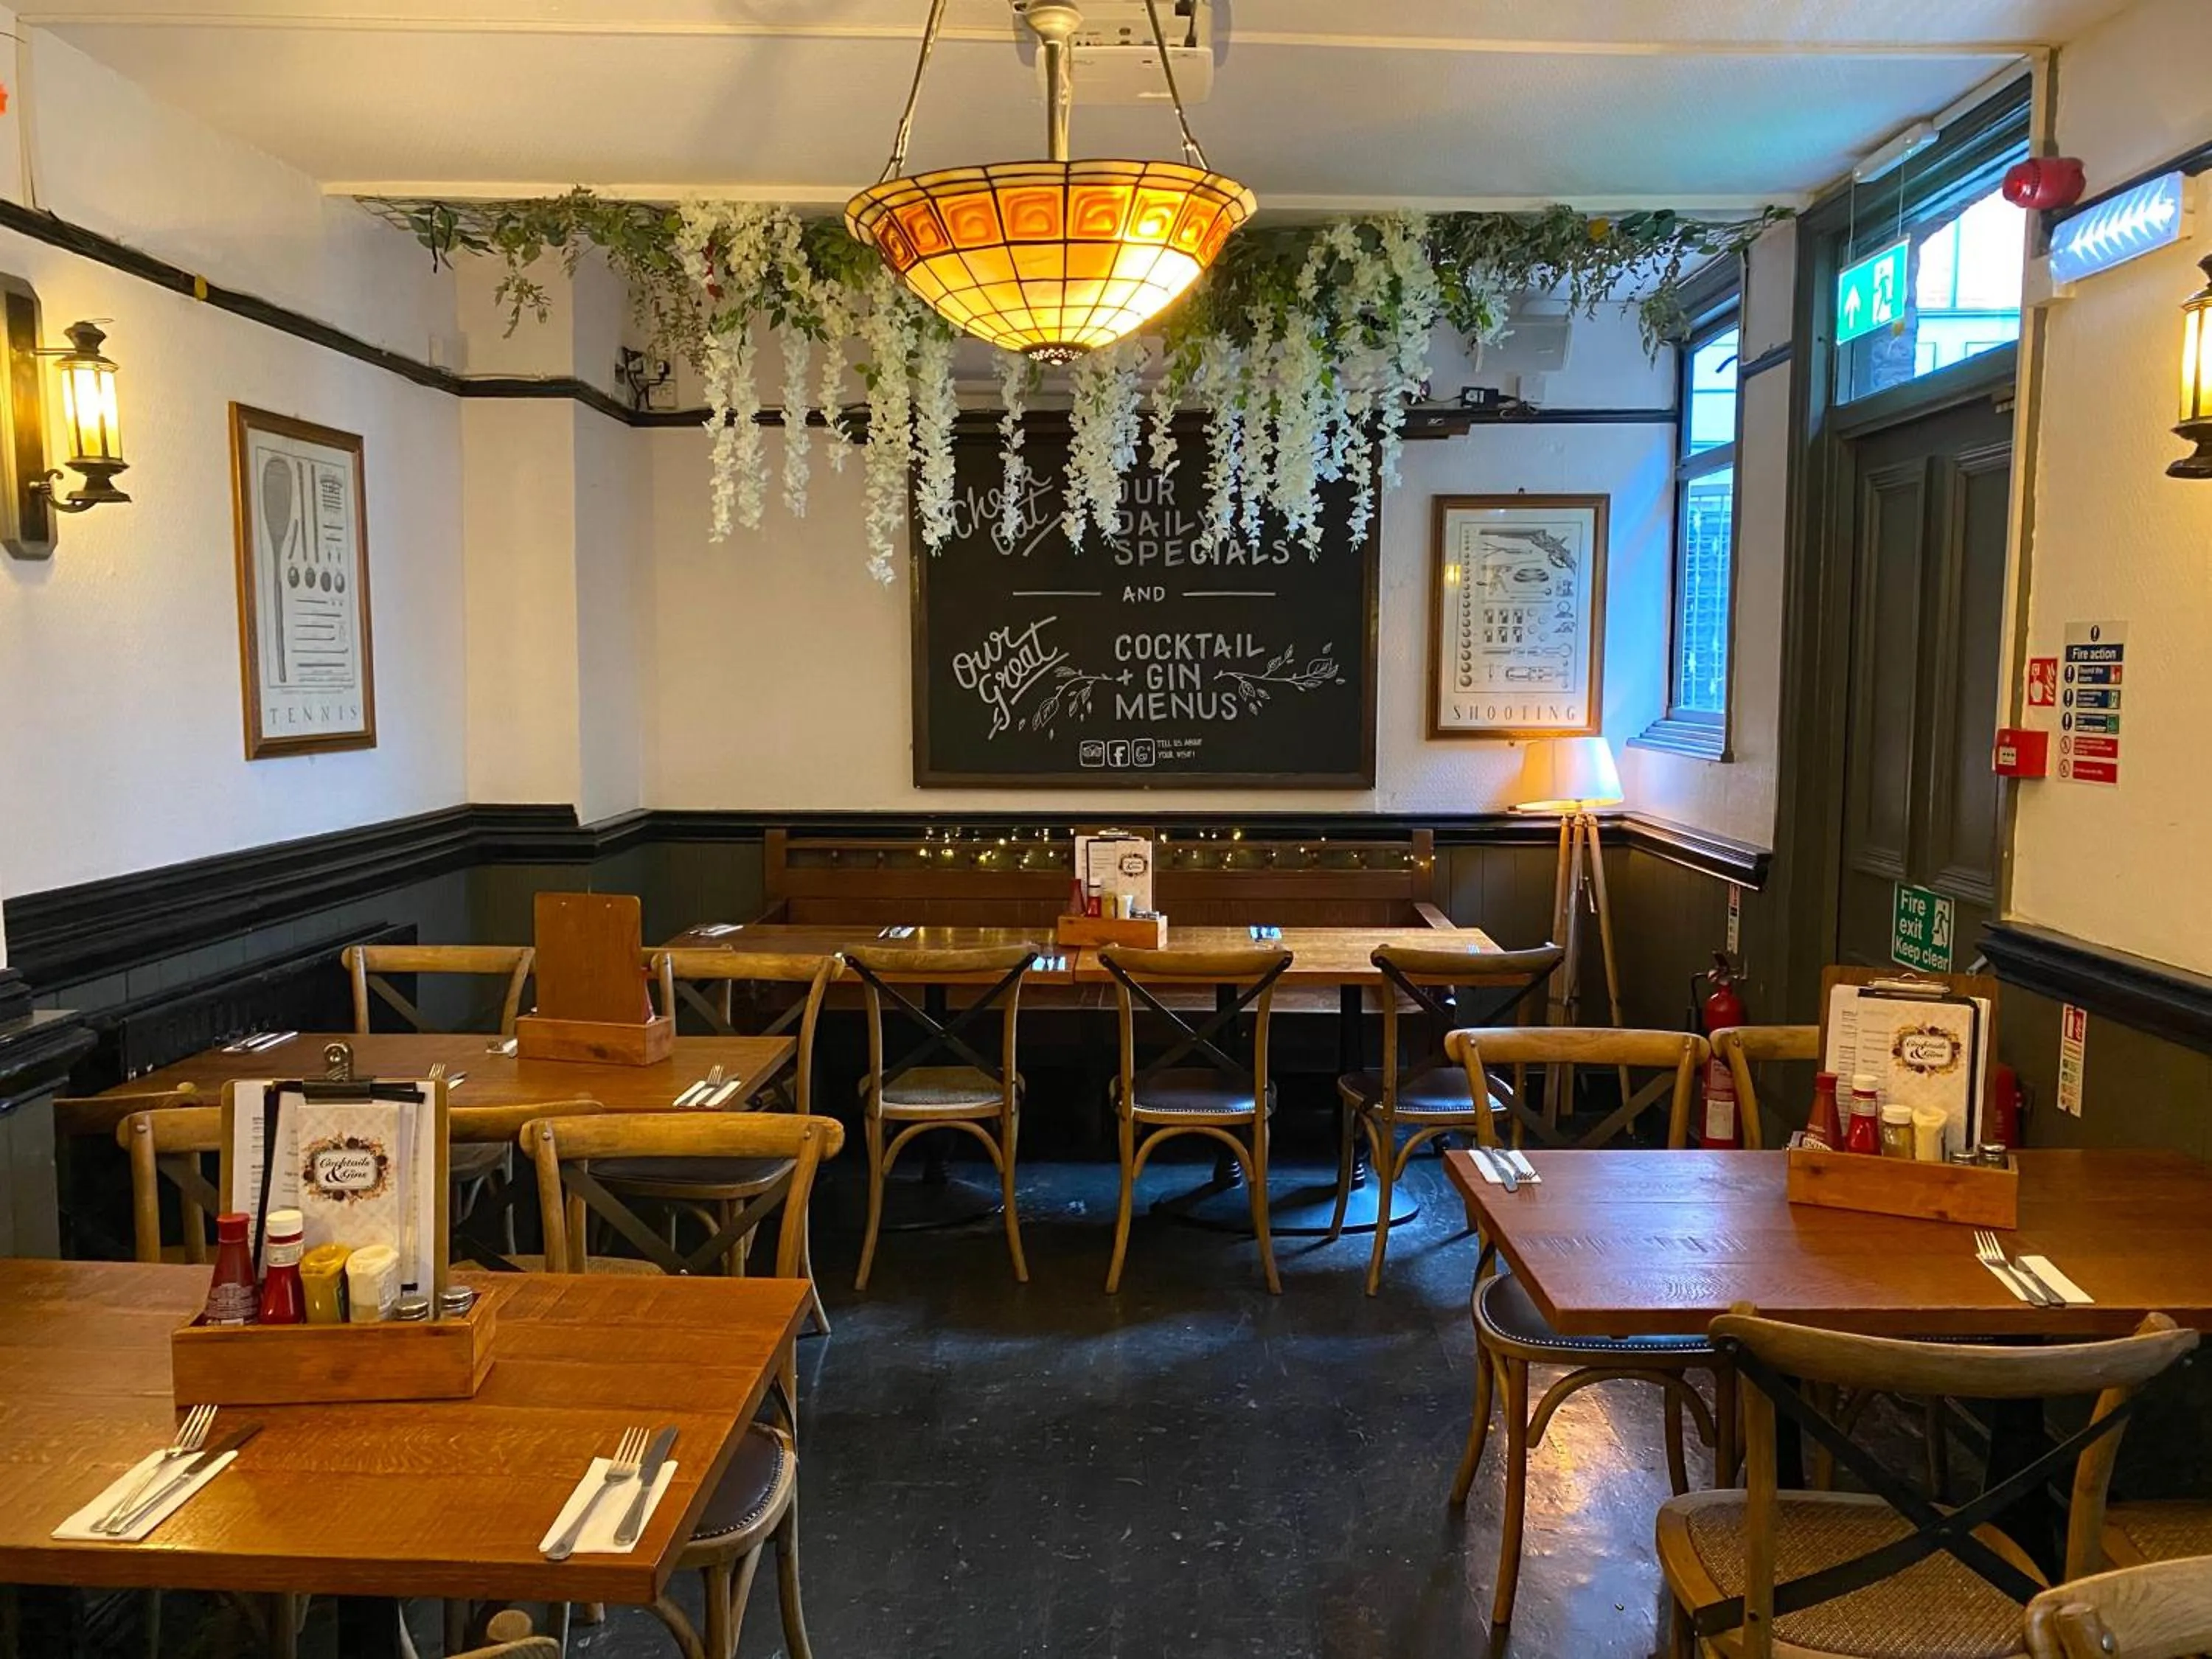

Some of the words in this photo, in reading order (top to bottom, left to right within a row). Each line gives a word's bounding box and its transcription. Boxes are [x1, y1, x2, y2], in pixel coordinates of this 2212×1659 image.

[1122, 586, 1166, 602] AND
[953, 626, 1021, 689] Our
[1115, 633, 1265, 661] COCKTAIL
[2072, 647, 2089, 660] Fire
[2090, 647, 2117, 660] action
[1147, 663, 1200, 691] GIN
[269, 705, 358, 725] TENNIS
[1116, 692, 1238, 720] MENUS
[1453, 705, 1576, 721] SHOOTING
[1900, 888, 1927, 917] Fire
[1899, 917, 1923, 940] exit
[1896, 935, 1921, 964] Keep
[1922, 947, 1949, 971] clear
